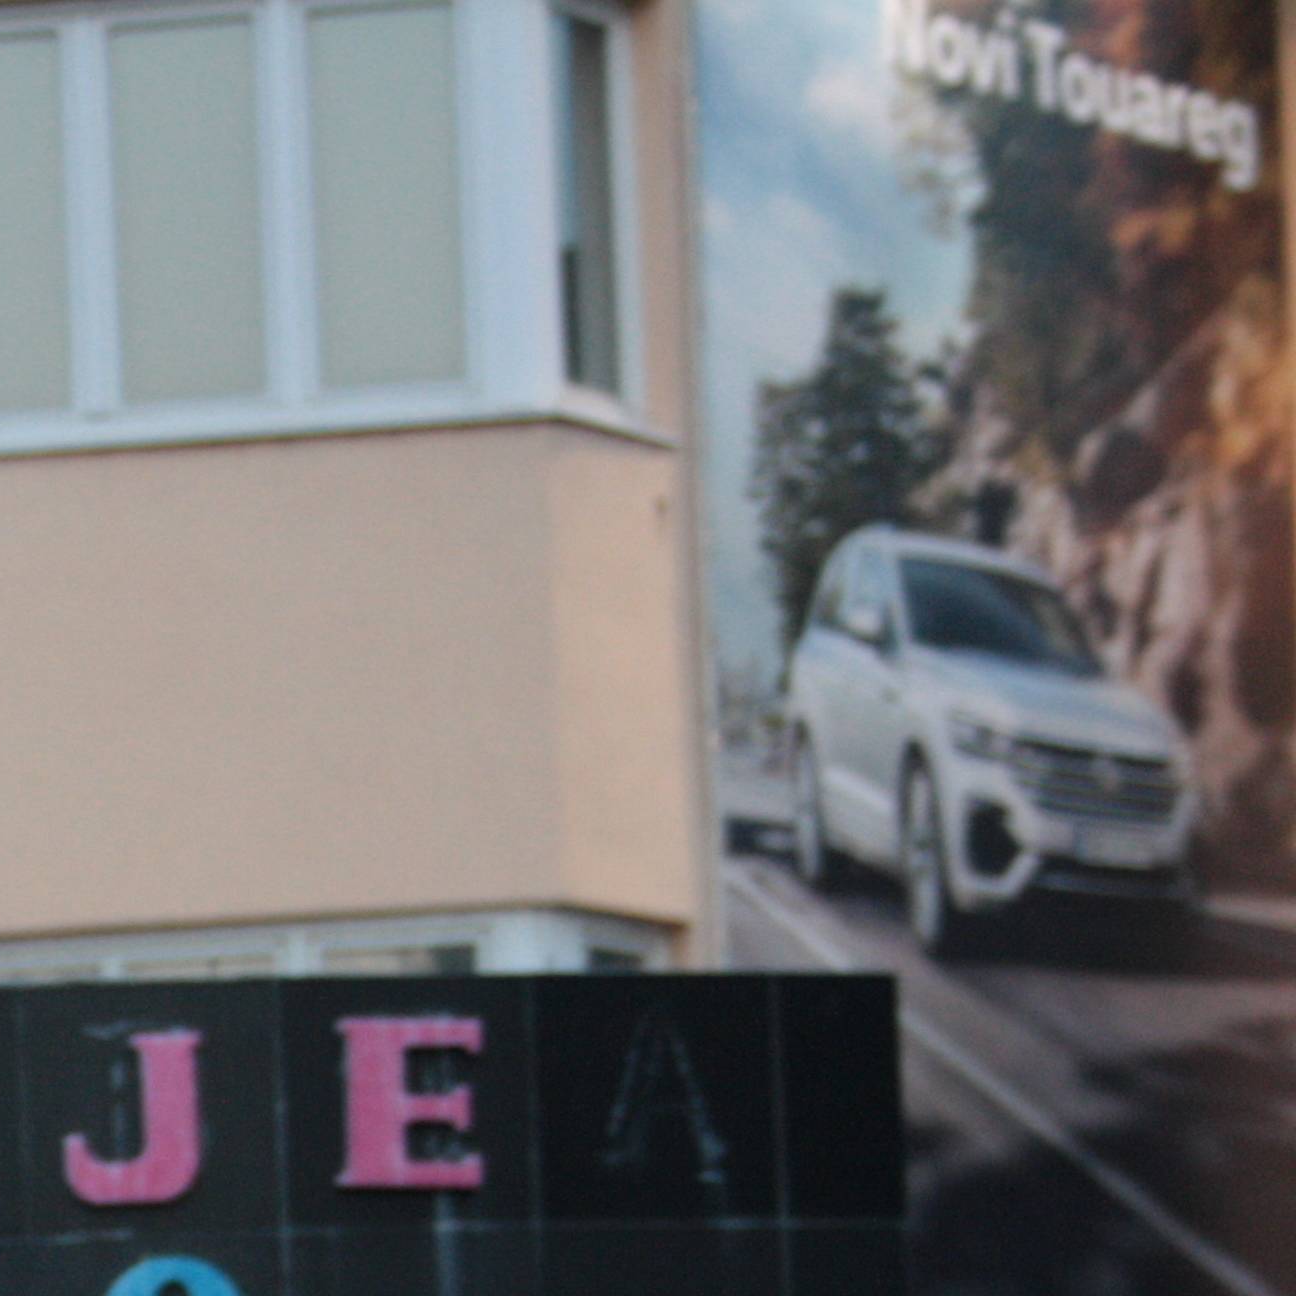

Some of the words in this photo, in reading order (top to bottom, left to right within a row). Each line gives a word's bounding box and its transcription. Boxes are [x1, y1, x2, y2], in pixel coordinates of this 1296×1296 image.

[890, 0, 1017, 96] Novi
[1022, 17, 1260, 191] Touareg
[63, 1016, 484, 1206] JE
